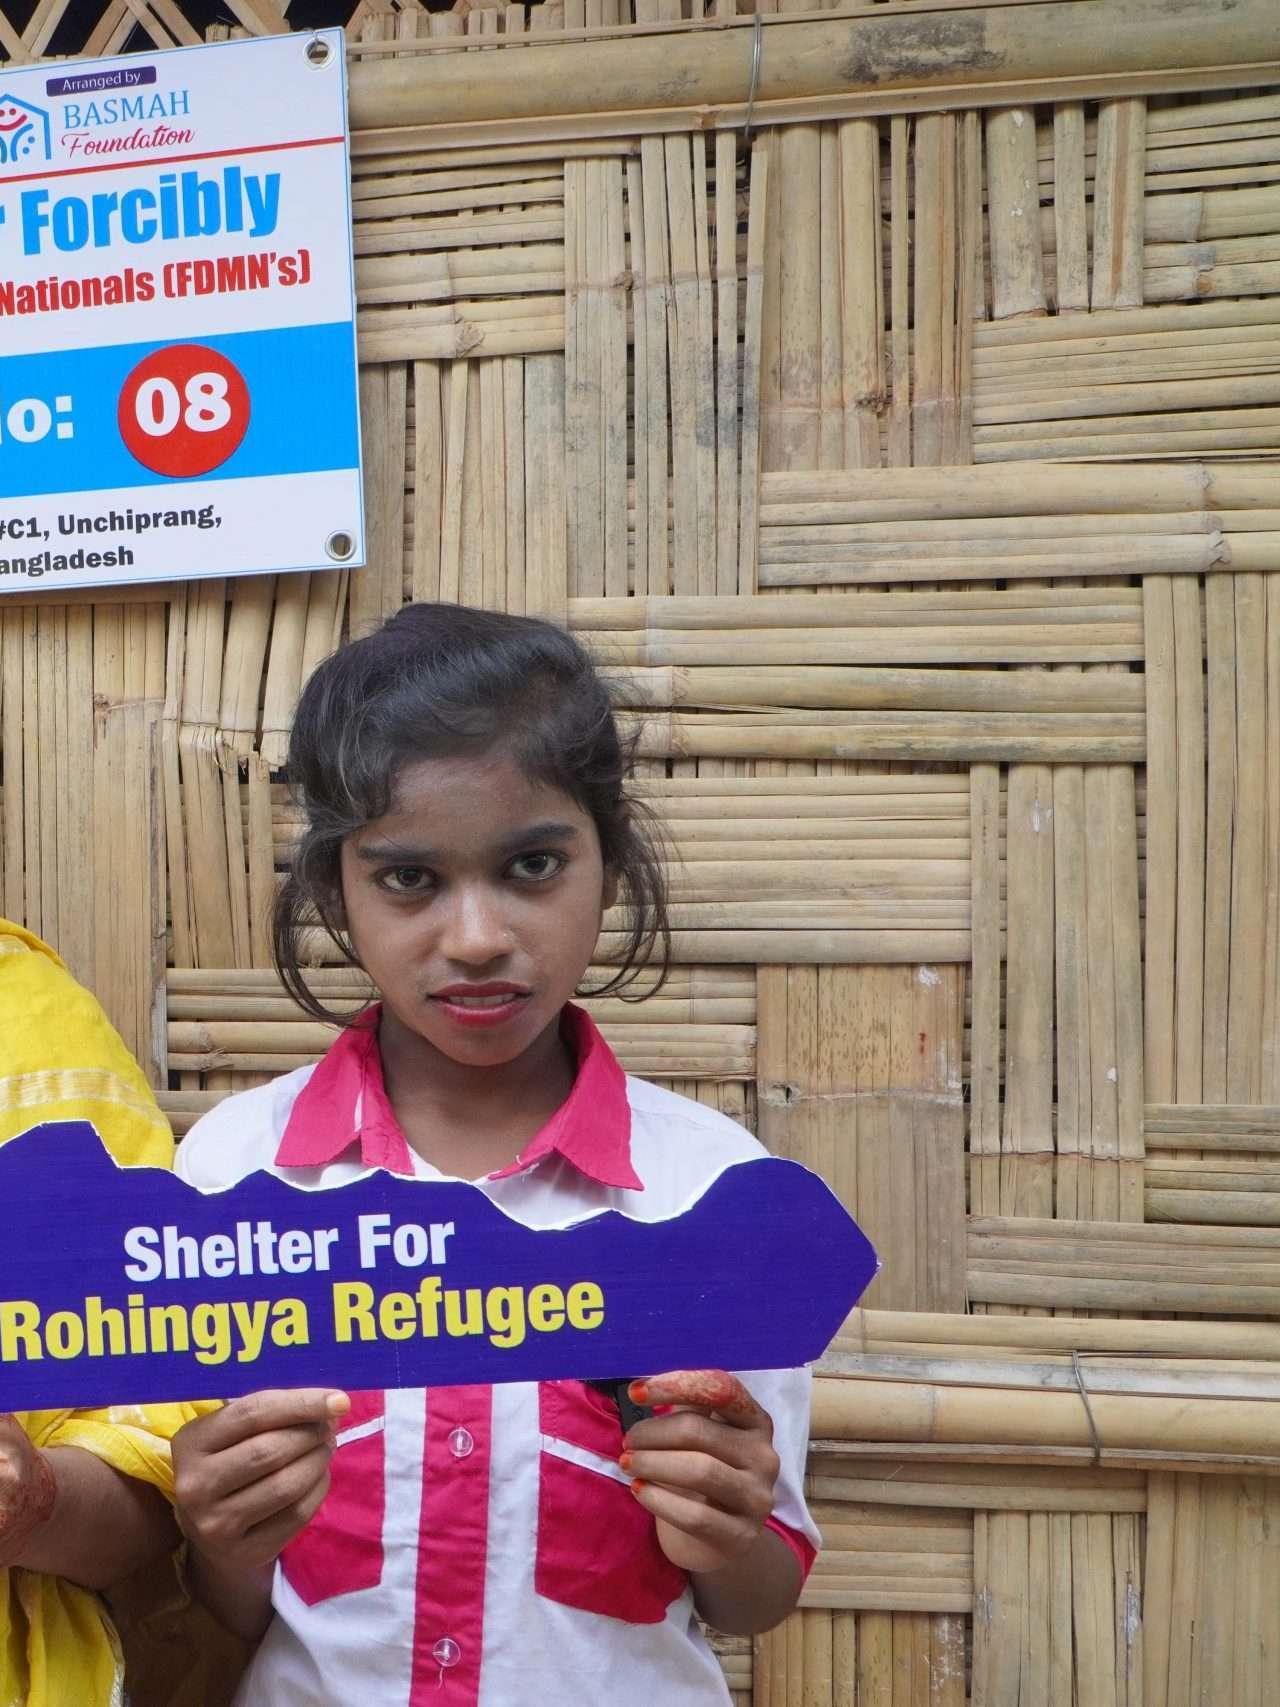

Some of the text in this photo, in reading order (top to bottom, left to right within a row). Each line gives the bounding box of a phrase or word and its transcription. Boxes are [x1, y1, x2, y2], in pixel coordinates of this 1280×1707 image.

[62, 71, 141, 92] Arranged by
[64, 90, 191, 129] BASMAH
[61, 124, 195, 158] Foundation
[21, 166, 280, 256] Forcibly
[163, 249, 310, 298] (FDMN's)
[135, 372, 232, 437] 08
[58, 505, 222, 535] Unchiprang,
[125, 1214, 455, 1282] Shelter For
[0, 1277, 604, 1365] Rohingya Refugee
